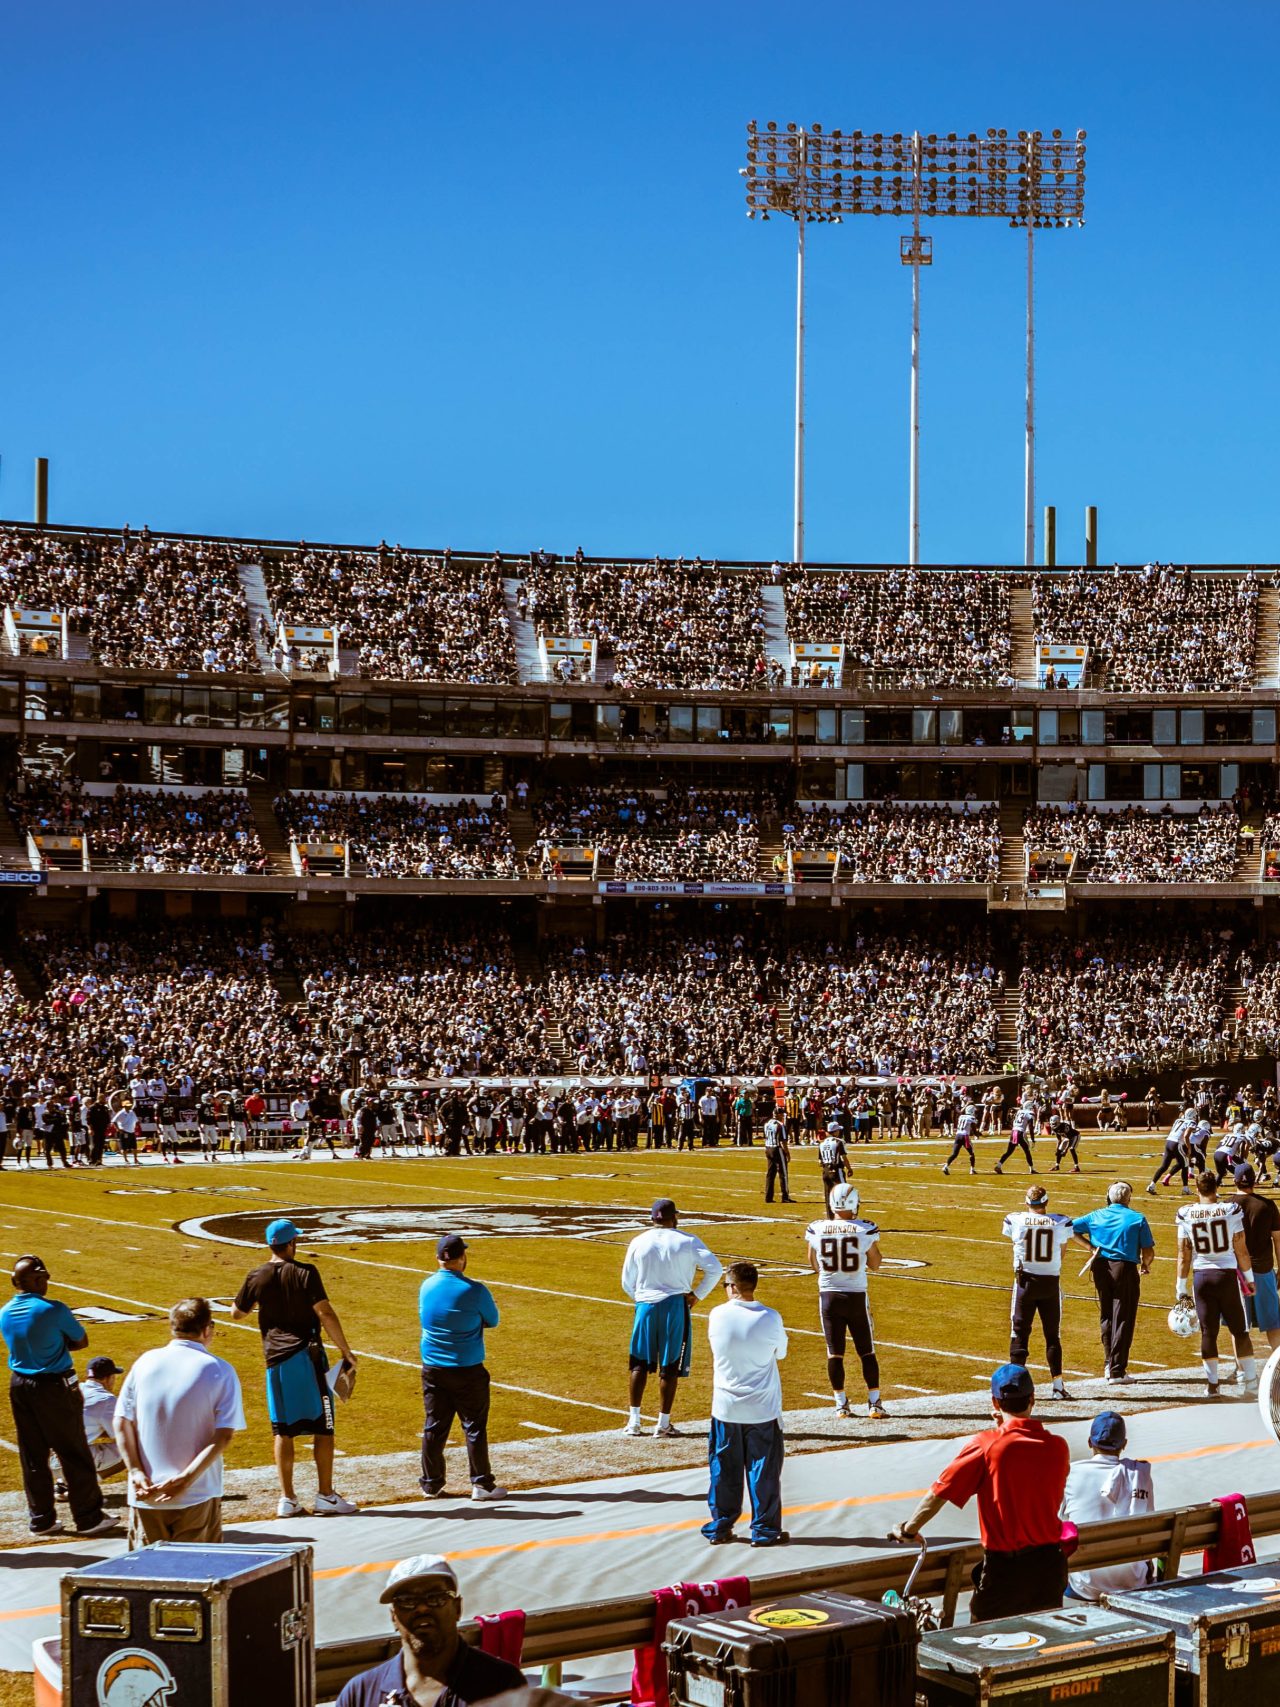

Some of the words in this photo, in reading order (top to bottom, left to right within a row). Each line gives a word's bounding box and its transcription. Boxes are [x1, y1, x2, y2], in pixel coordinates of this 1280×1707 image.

[1190, 1207, 1227, 1219] ROBINSON
[823, 1225, 857, 1234] JOHNSON
[1191, 1219, 1229, 1255] 60
[821, 1236, 859, 1273] 96
[1023, 1228, 1054, 1263] 10
[1050, 1677, 1101, 1700] FRONT
